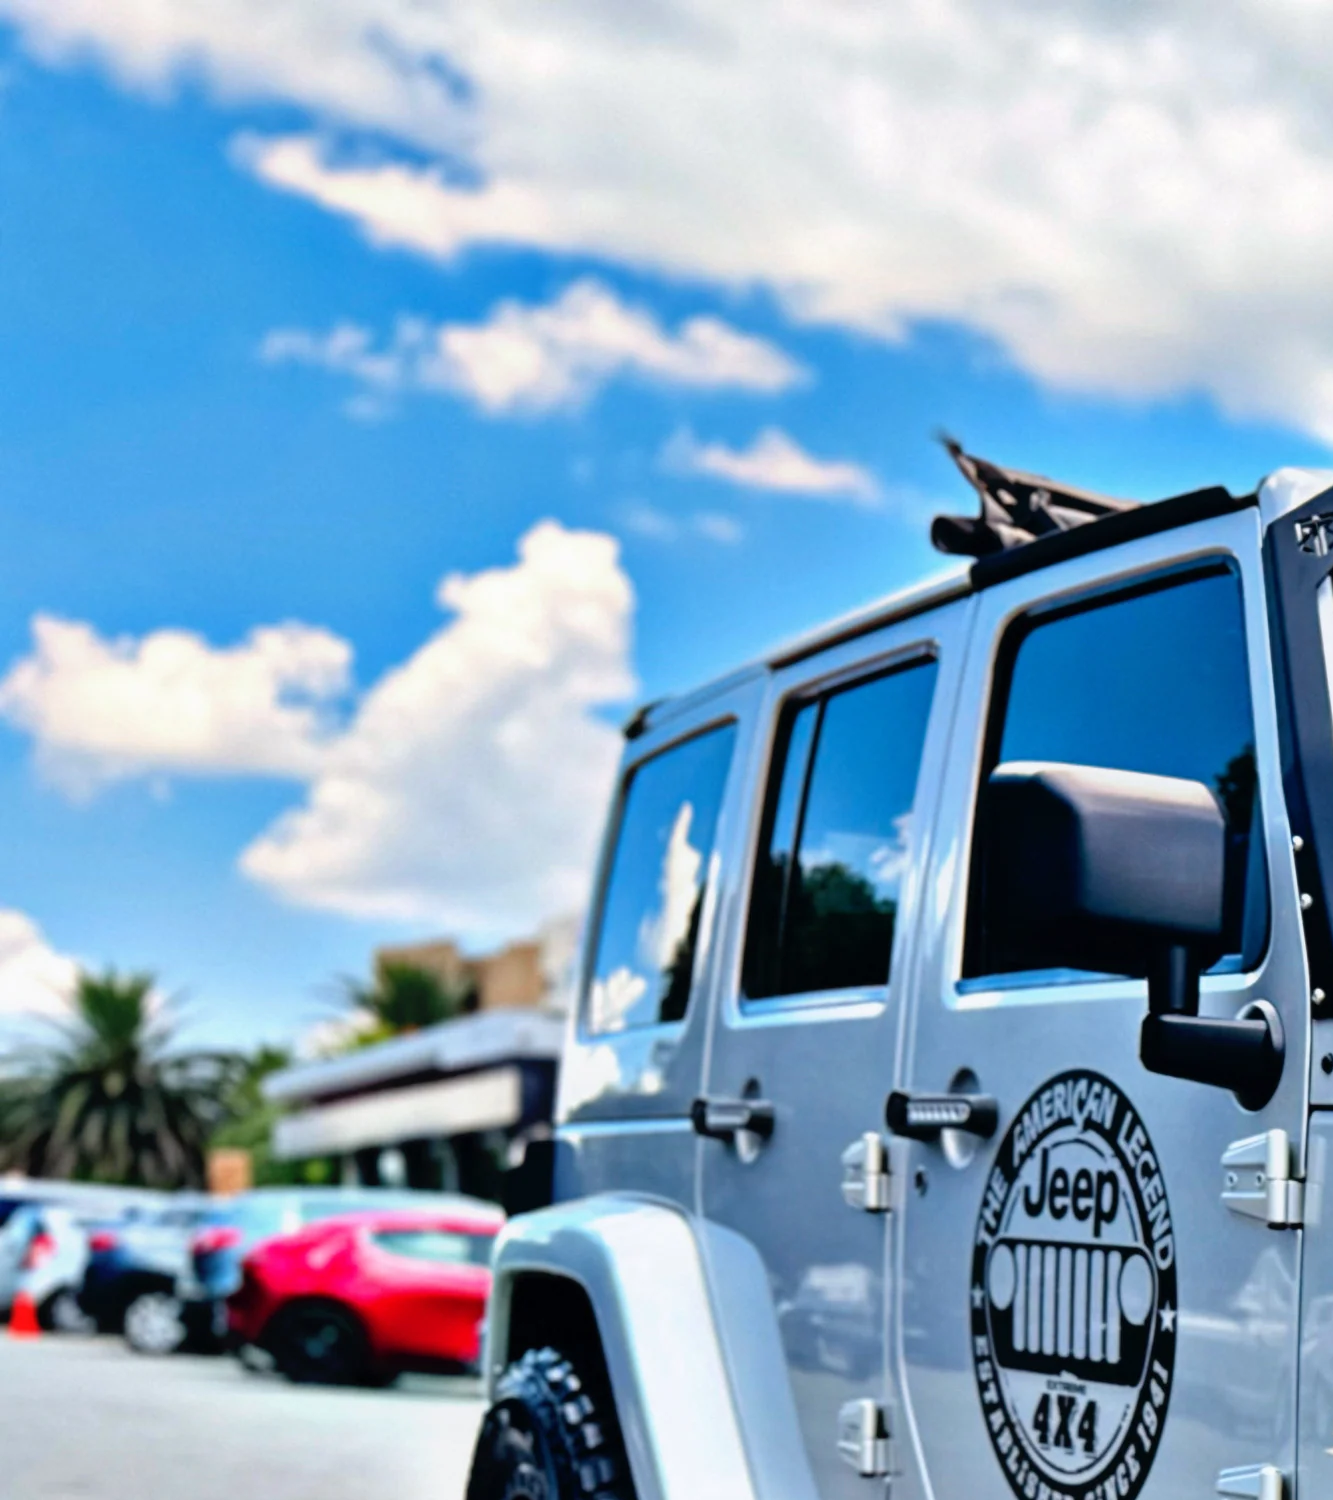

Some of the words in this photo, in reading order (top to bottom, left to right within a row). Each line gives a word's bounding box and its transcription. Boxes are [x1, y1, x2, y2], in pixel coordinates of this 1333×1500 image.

[977, 1165, 1009, 1249] THE
[1012, 1077, 1119, 1168] AMERICAN
[1116, 1110, 1175, 1271] LEGEND
[1023, 1146, 1121, 1239] Jeep
[1032, 1392, 1099, 1460] 4X4
[1046, 1378, 1087, 1395] EXTREME
[1137, 1358, 1169, 1453] 1941
